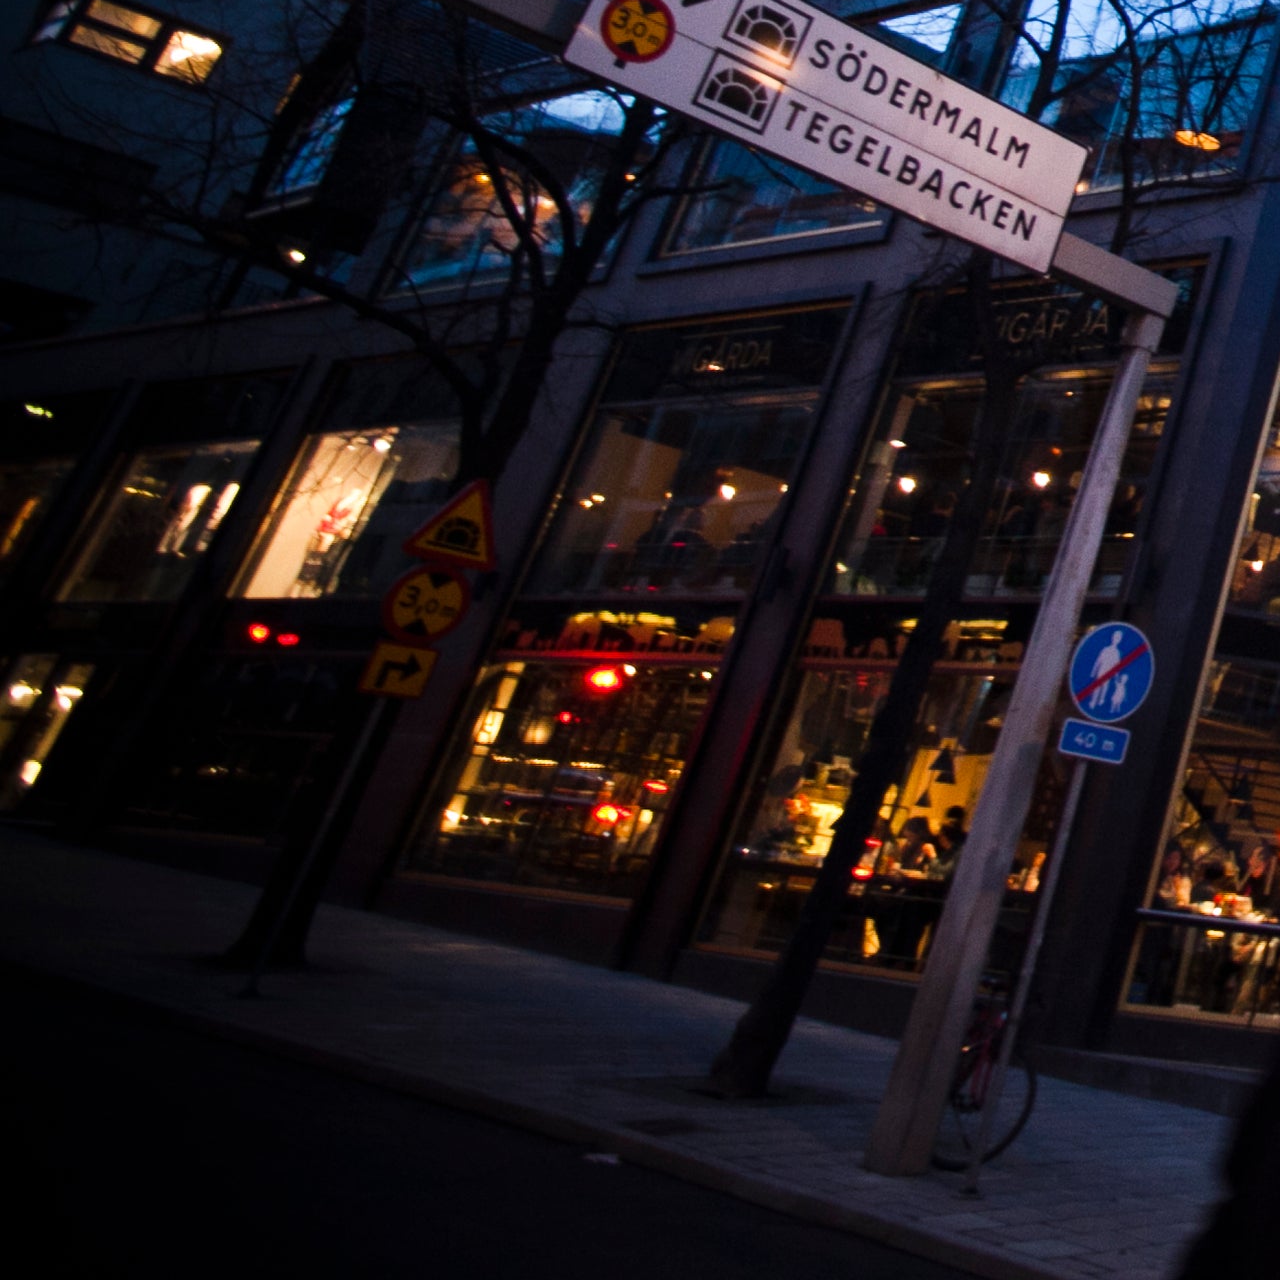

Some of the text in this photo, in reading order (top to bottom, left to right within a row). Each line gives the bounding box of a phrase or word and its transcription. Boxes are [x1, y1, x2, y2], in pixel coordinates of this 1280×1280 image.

[808, 37, 1031, 170] SÖDERMALM
[784, 99, 1039, 242] TEGELBACKEN
[1075, 732, 1097, 749] 40
